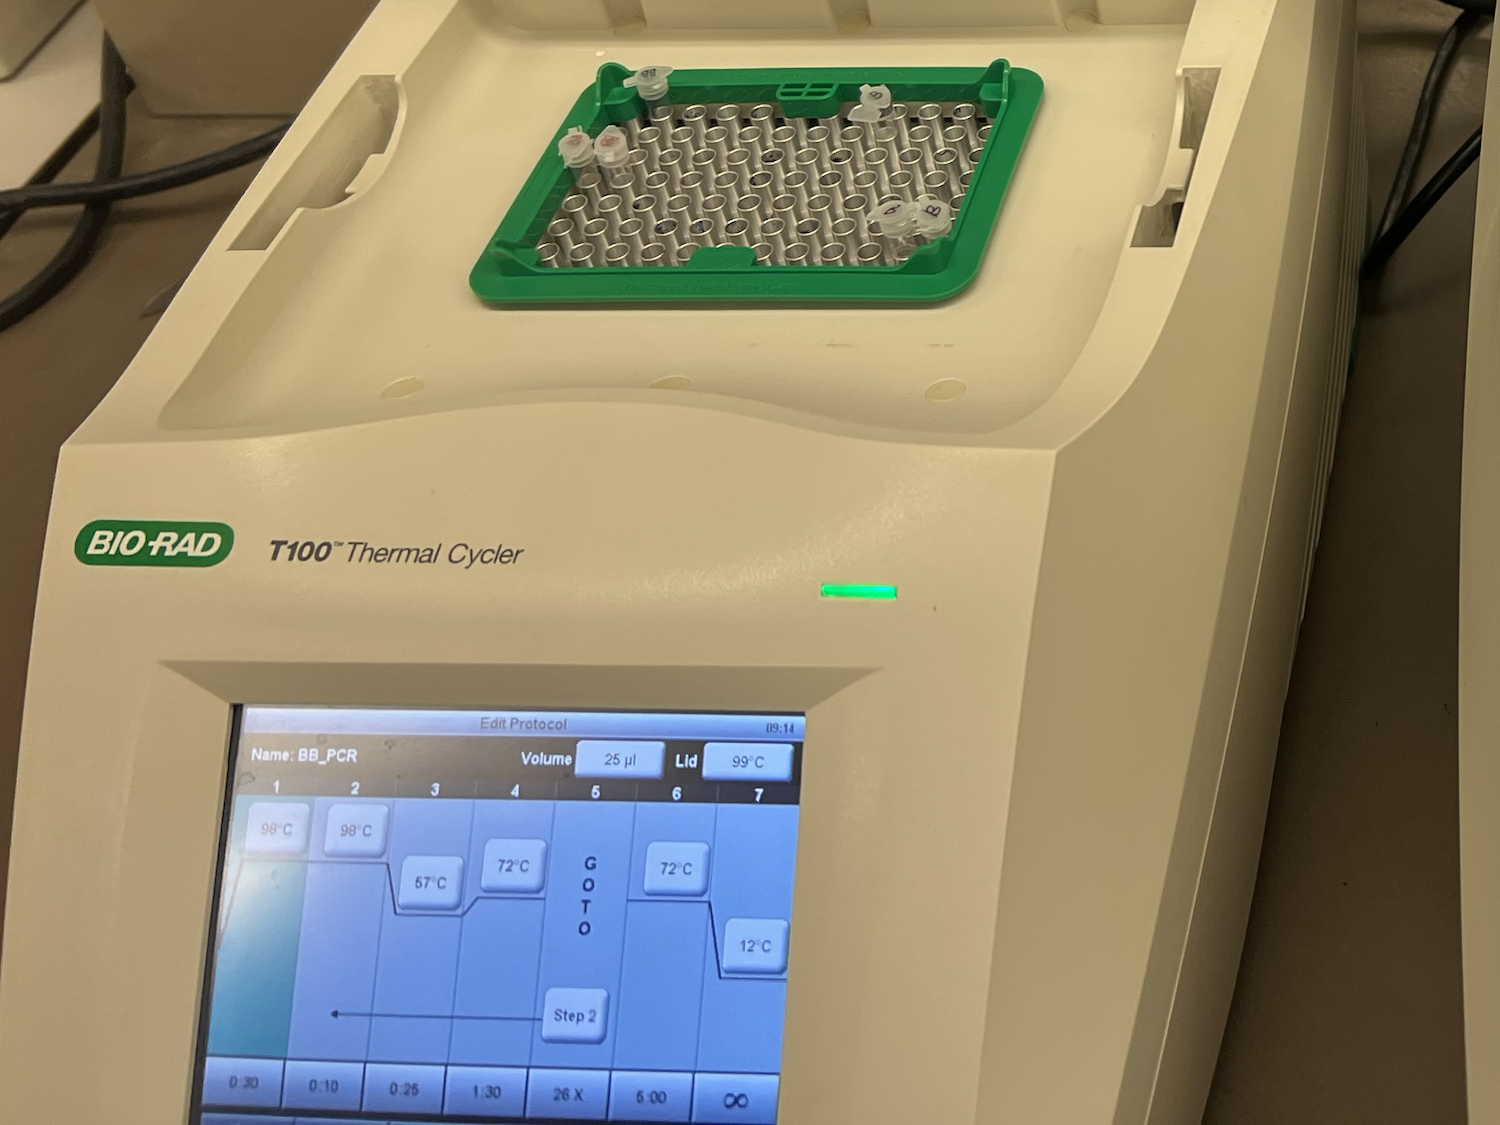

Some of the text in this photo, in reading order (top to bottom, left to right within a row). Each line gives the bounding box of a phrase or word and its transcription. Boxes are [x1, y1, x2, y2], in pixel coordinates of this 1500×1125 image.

[86, 530, 222, 557] BIO-RAD
[347, 541, 440, 565] Thermal
[447, 543, 525, 569] Cycler
[480, 717, 568, 732] Edit Protocol
[251, 748, 358, 765] Name: BB_PCR
[520, 751, 573, 766] Volume
[604, 753, 621, 766] 25
[675, 753, 698, 769] Lid
[731, 755, 765, 769] 99°C
[273, 780, 764, 802] 1 2 3 4 5 6 7
[498, 858, 530, 873] 72°C
[660, 861, 693, 876] 72°C
[740, 939, 772, 954] 12°C
[554, 1008, 597, 1025] Step 2
